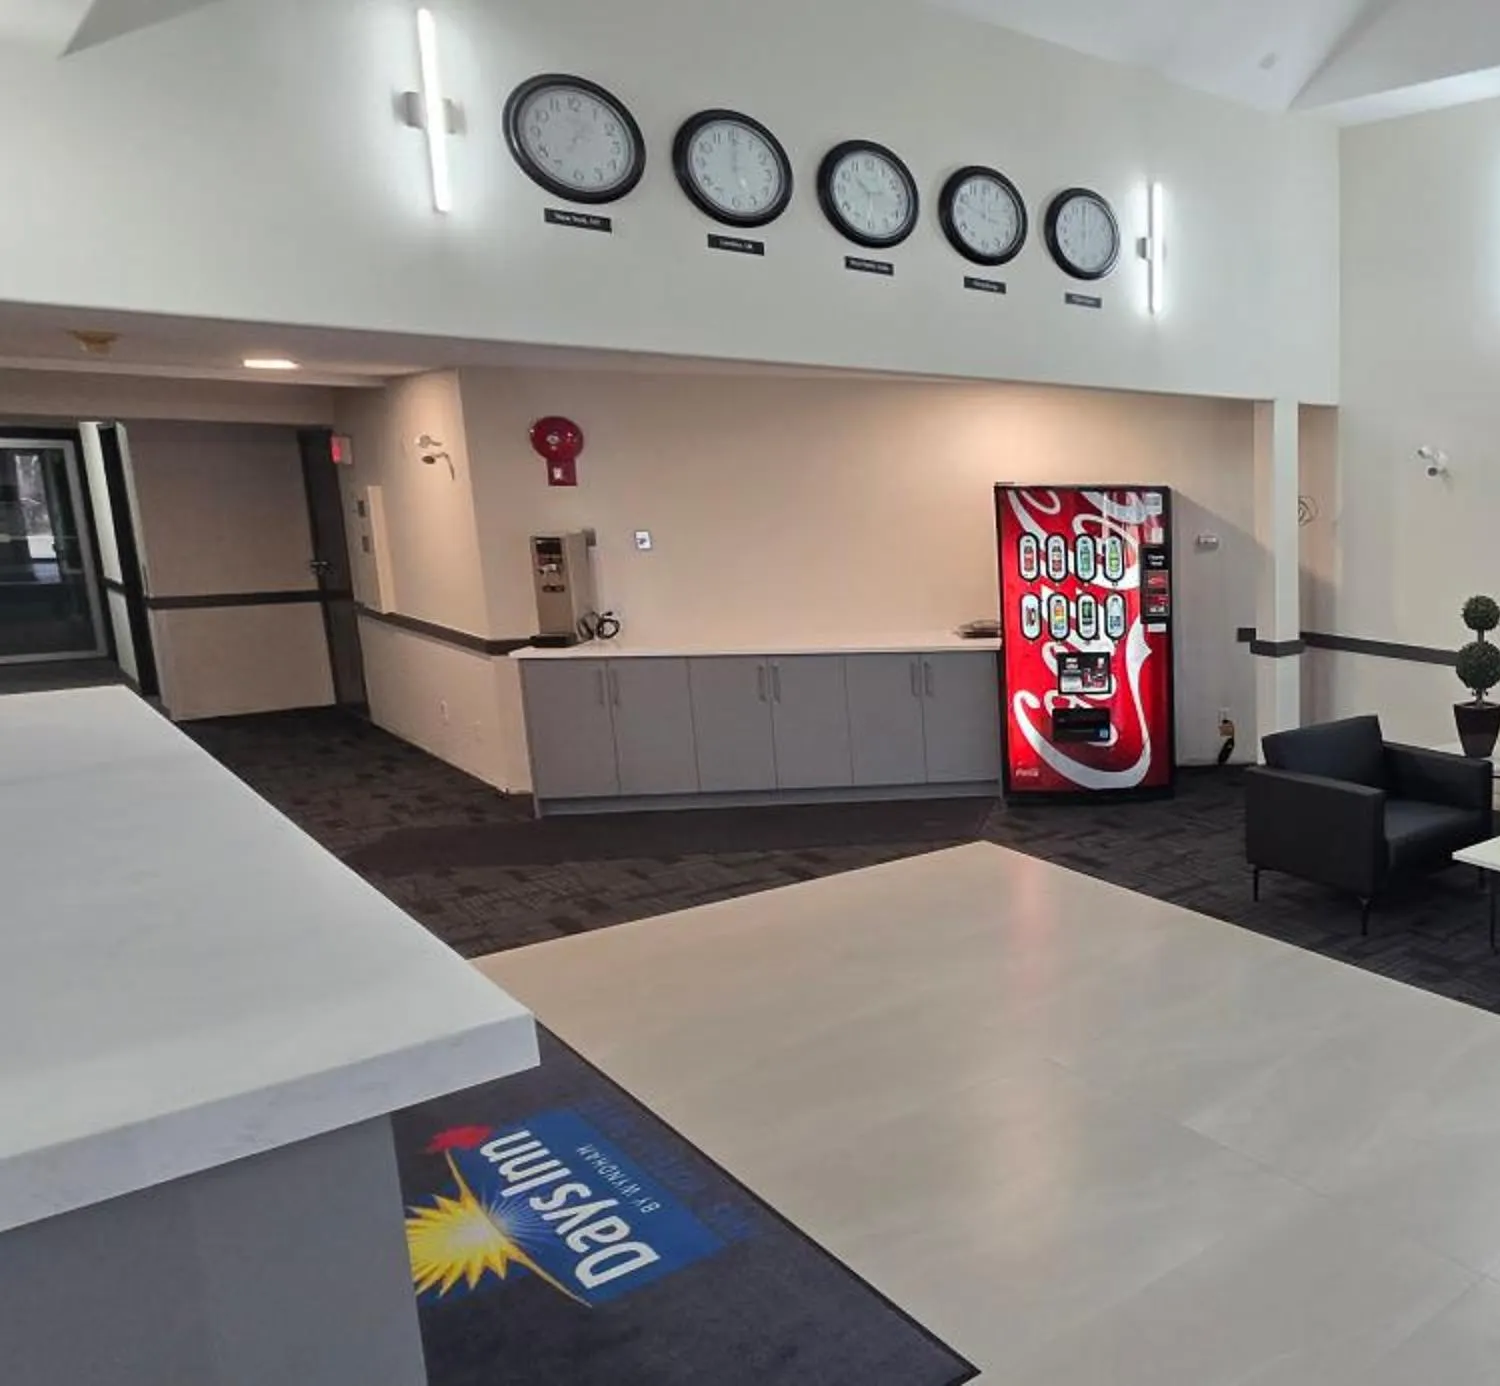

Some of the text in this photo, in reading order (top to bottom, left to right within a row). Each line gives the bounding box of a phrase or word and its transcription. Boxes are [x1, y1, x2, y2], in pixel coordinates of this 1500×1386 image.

[479, 1129, 661, 1289] Days Inn
[576, 1145, 661, 1214] BY WYNDHAM
